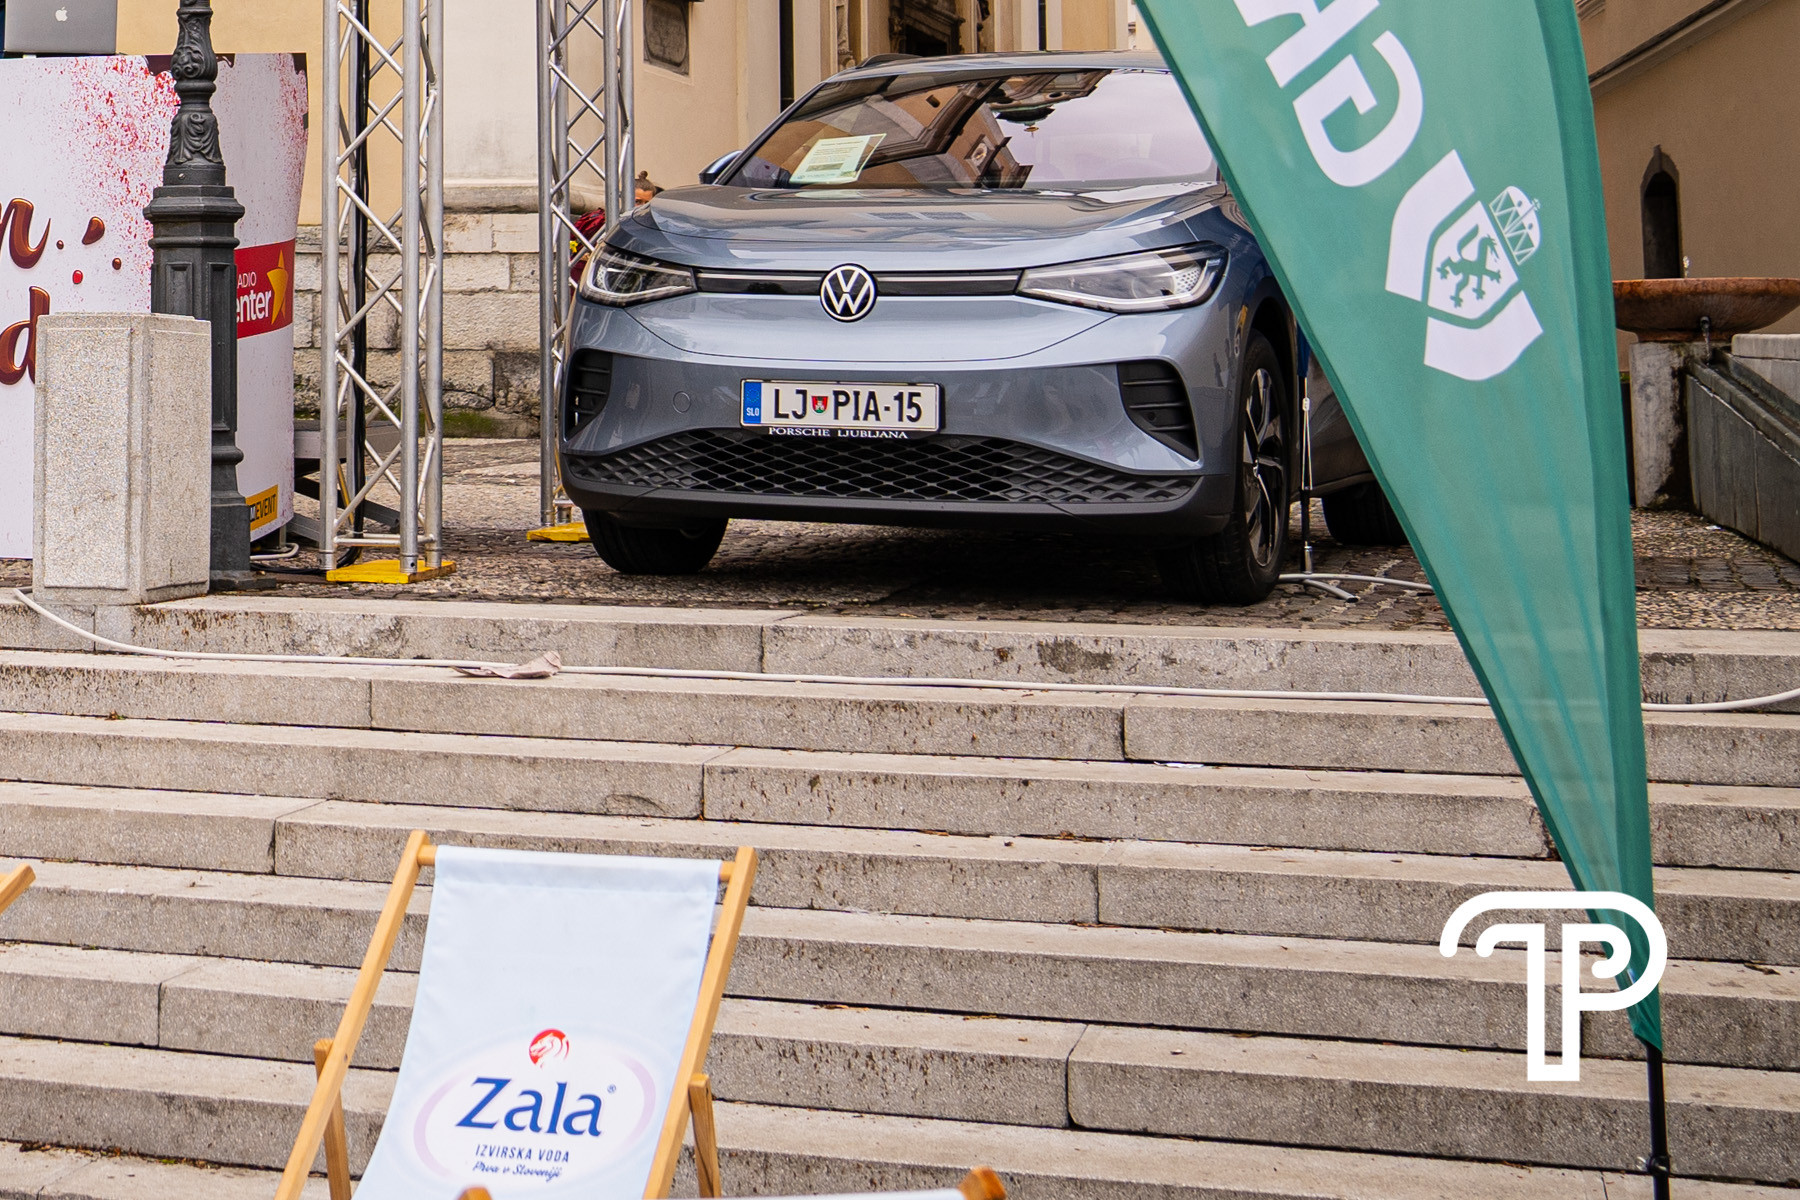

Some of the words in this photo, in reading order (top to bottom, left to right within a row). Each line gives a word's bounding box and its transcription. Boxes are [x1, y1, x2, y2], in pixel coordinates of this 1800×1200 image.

[236, 271, 257, 289] ADIO
[746, 407, 760, 417] SLO
[773, 388, 808, 420] LJ
[832, 389, 922, 423] PIA-15
[768, 427, 831, 438] PORSCHE
[837, 429, 908, 440] LJUBLJANA
[475, 1144, 532, 1161] IZVIRSKA
[538, 1149, 570, 1163] VODA
